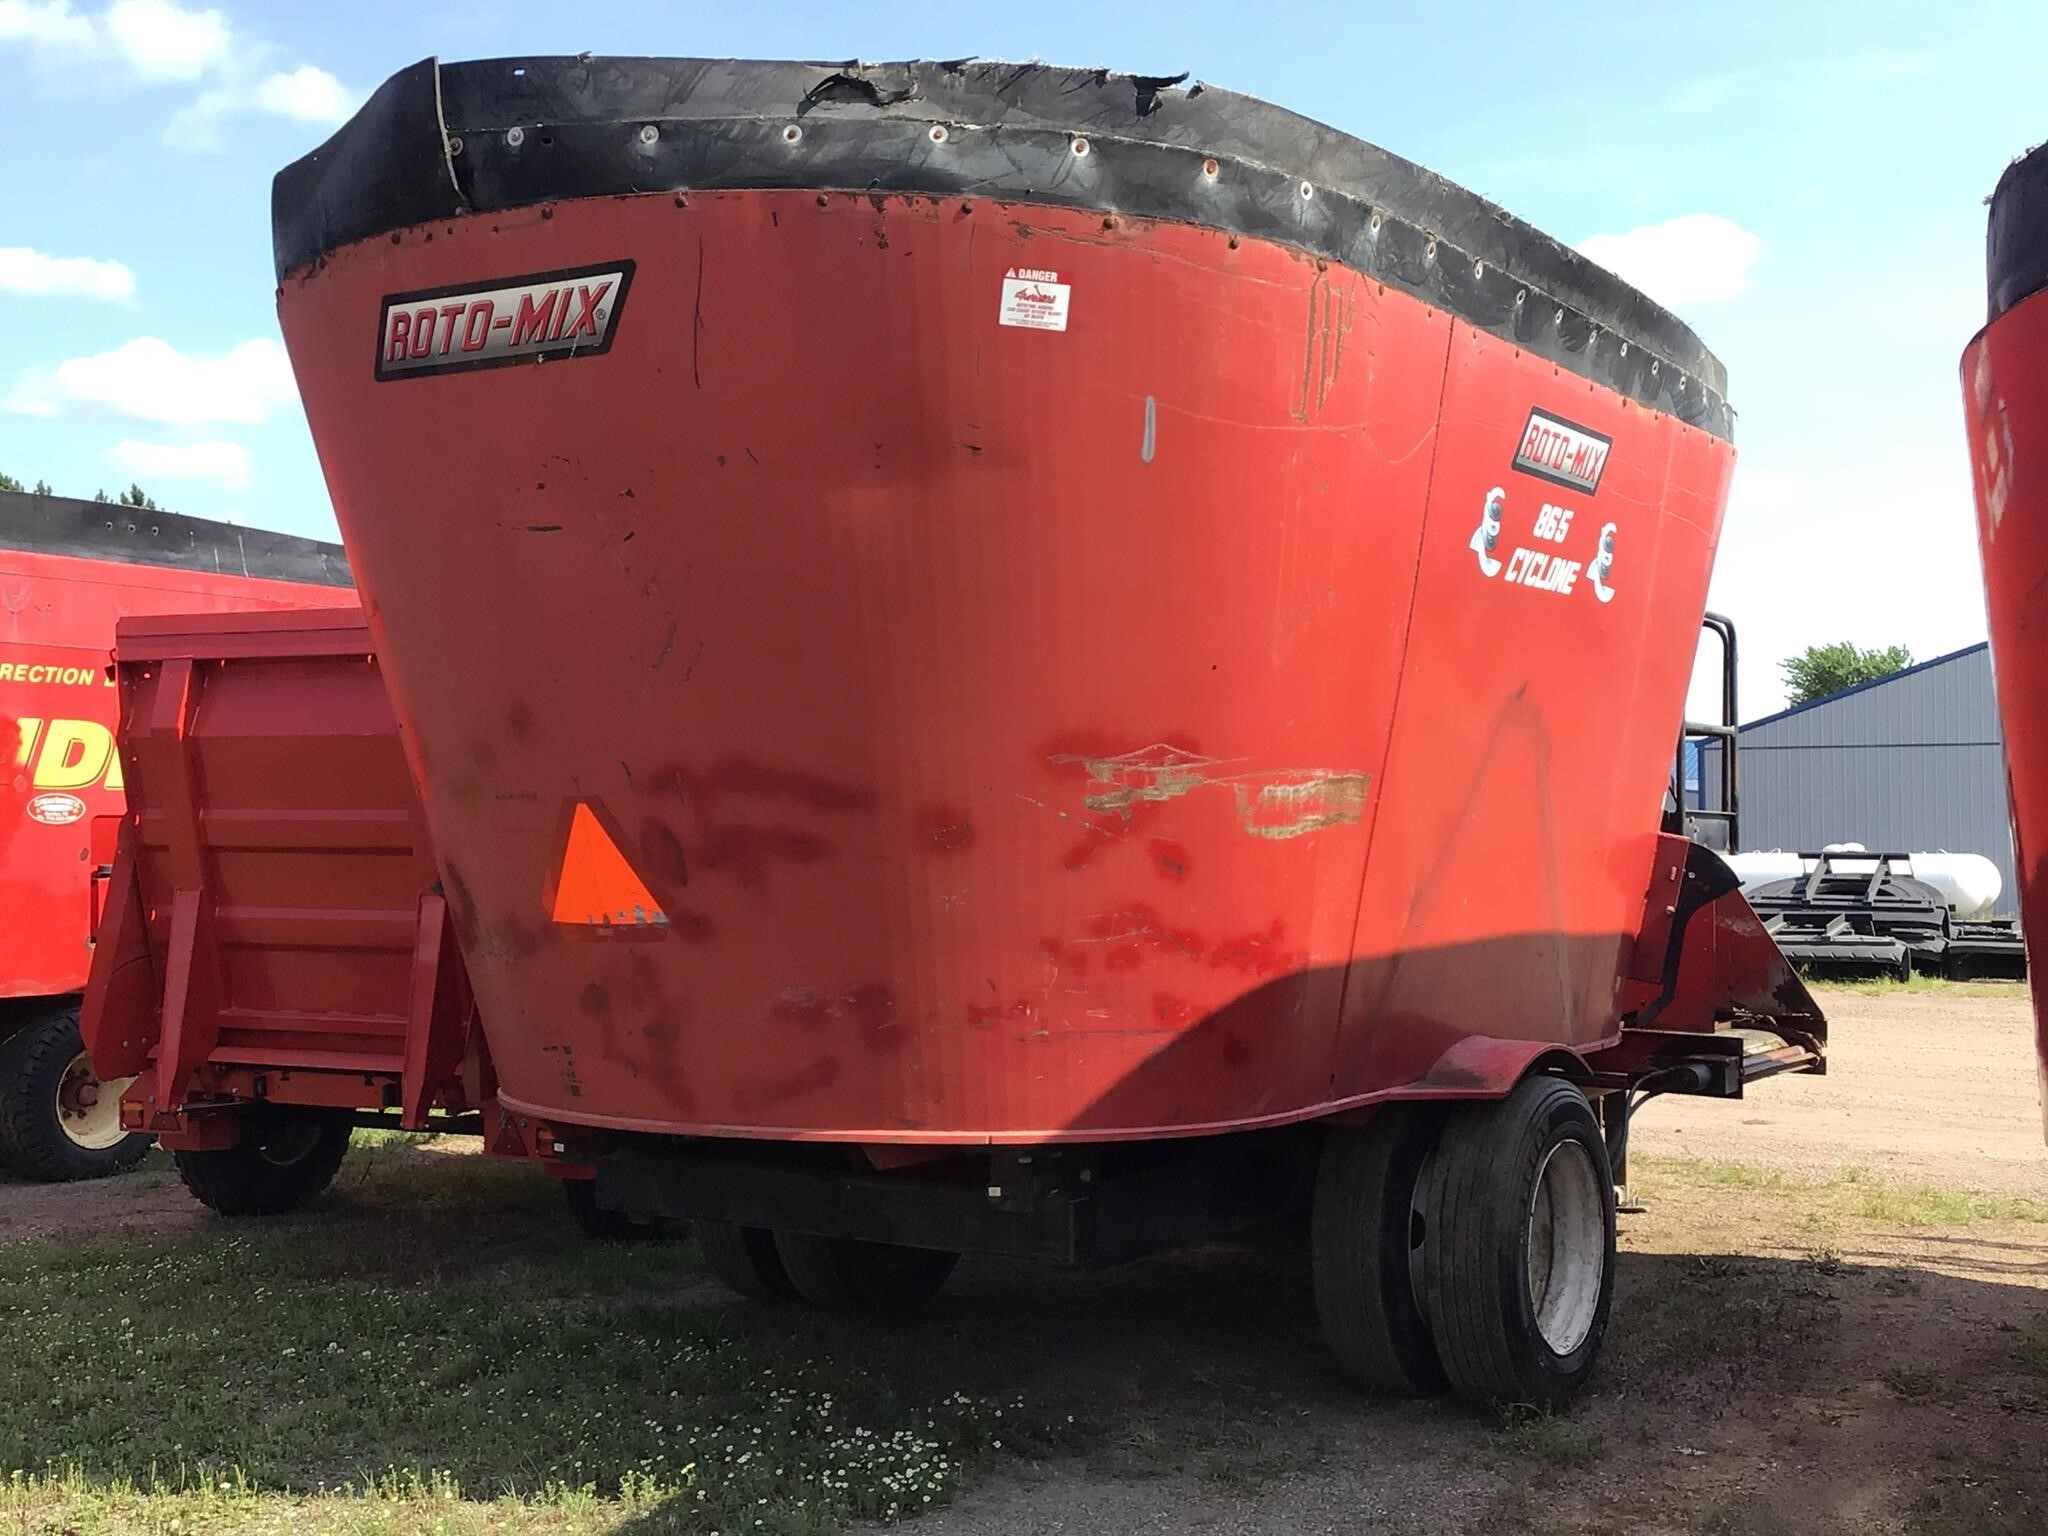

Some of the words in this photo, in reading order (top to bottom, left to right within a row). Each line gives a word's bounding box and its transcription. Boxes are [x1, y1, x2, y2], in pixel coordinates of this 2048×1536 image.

[1018, 268, 1058, 283] DANGER
[386, 281, 613, 361] ROTO-MIX
[1519, 424, 1605, 483] ROTO-MIX
[1532, 503, 1575, 543] 865
[1504, 547, 1582, 595] CYCLONE
